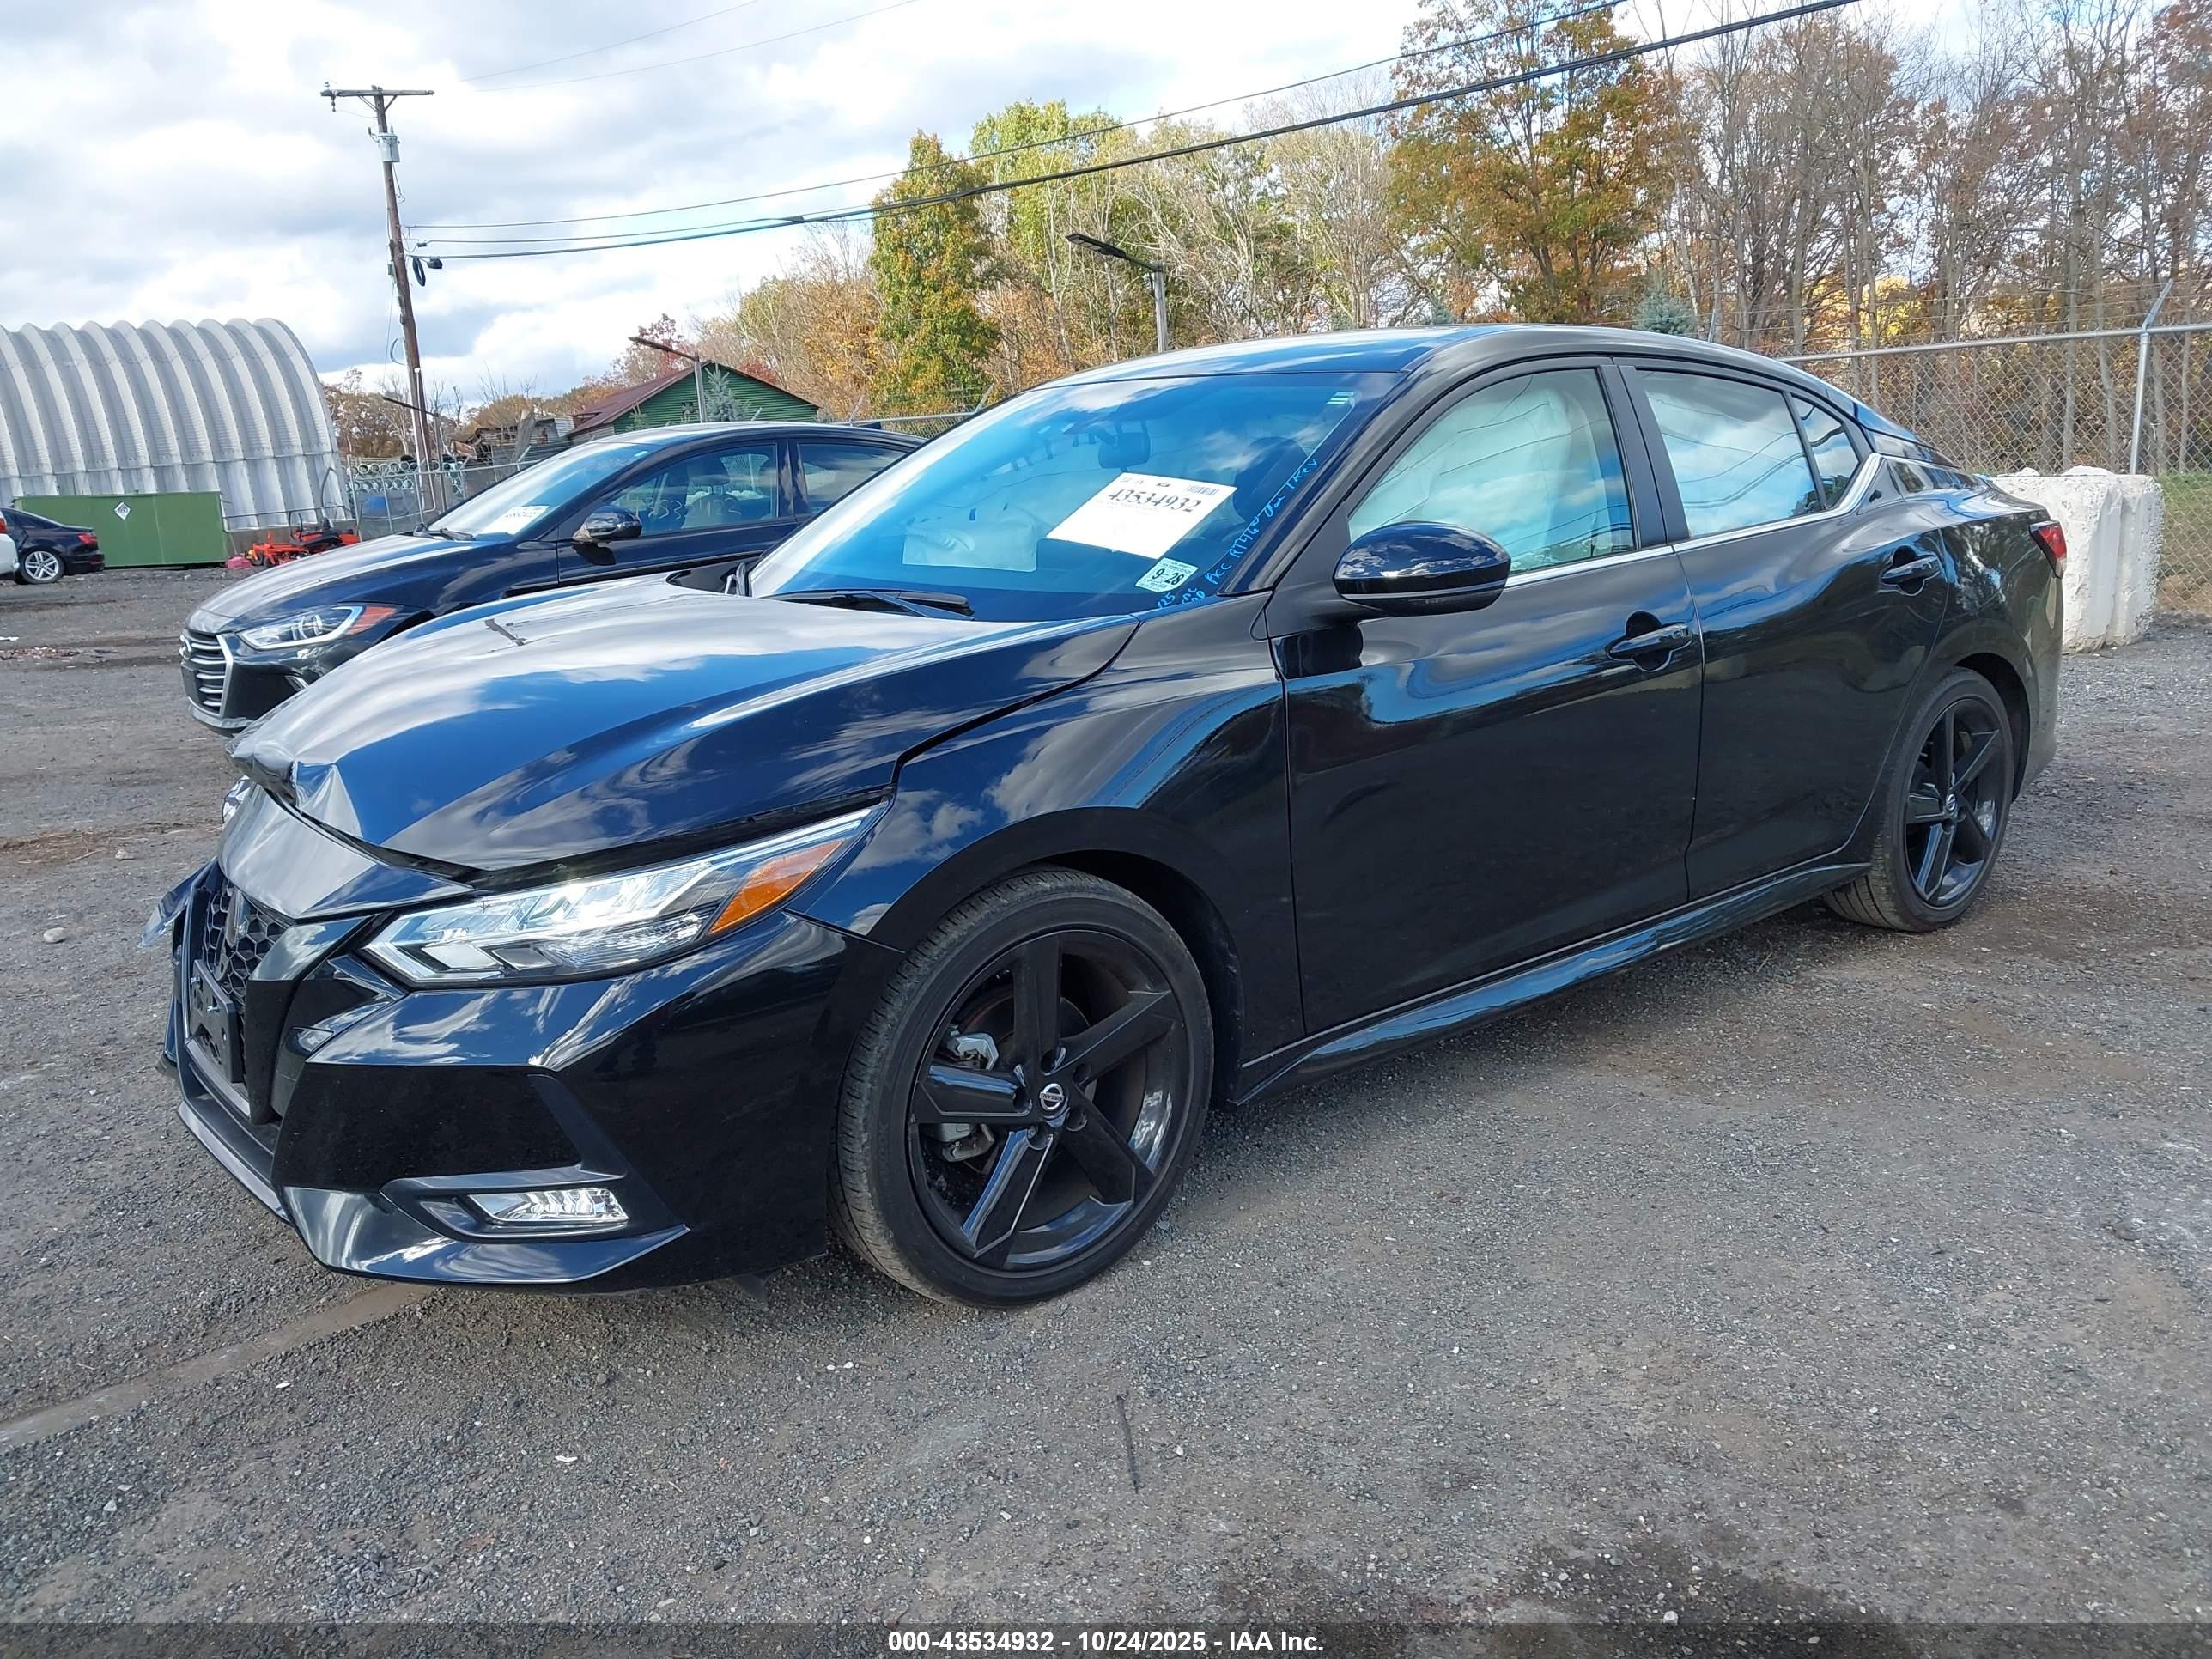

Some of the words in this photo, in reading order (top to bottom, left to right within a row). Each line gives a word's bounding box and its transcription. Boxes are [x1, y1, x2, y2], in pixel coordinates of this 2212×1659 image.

[1108, 488, 1202, 513] 43534932
[1152, 568, 1166, 580] 9
[1164, 572, 1185, 586] 28
